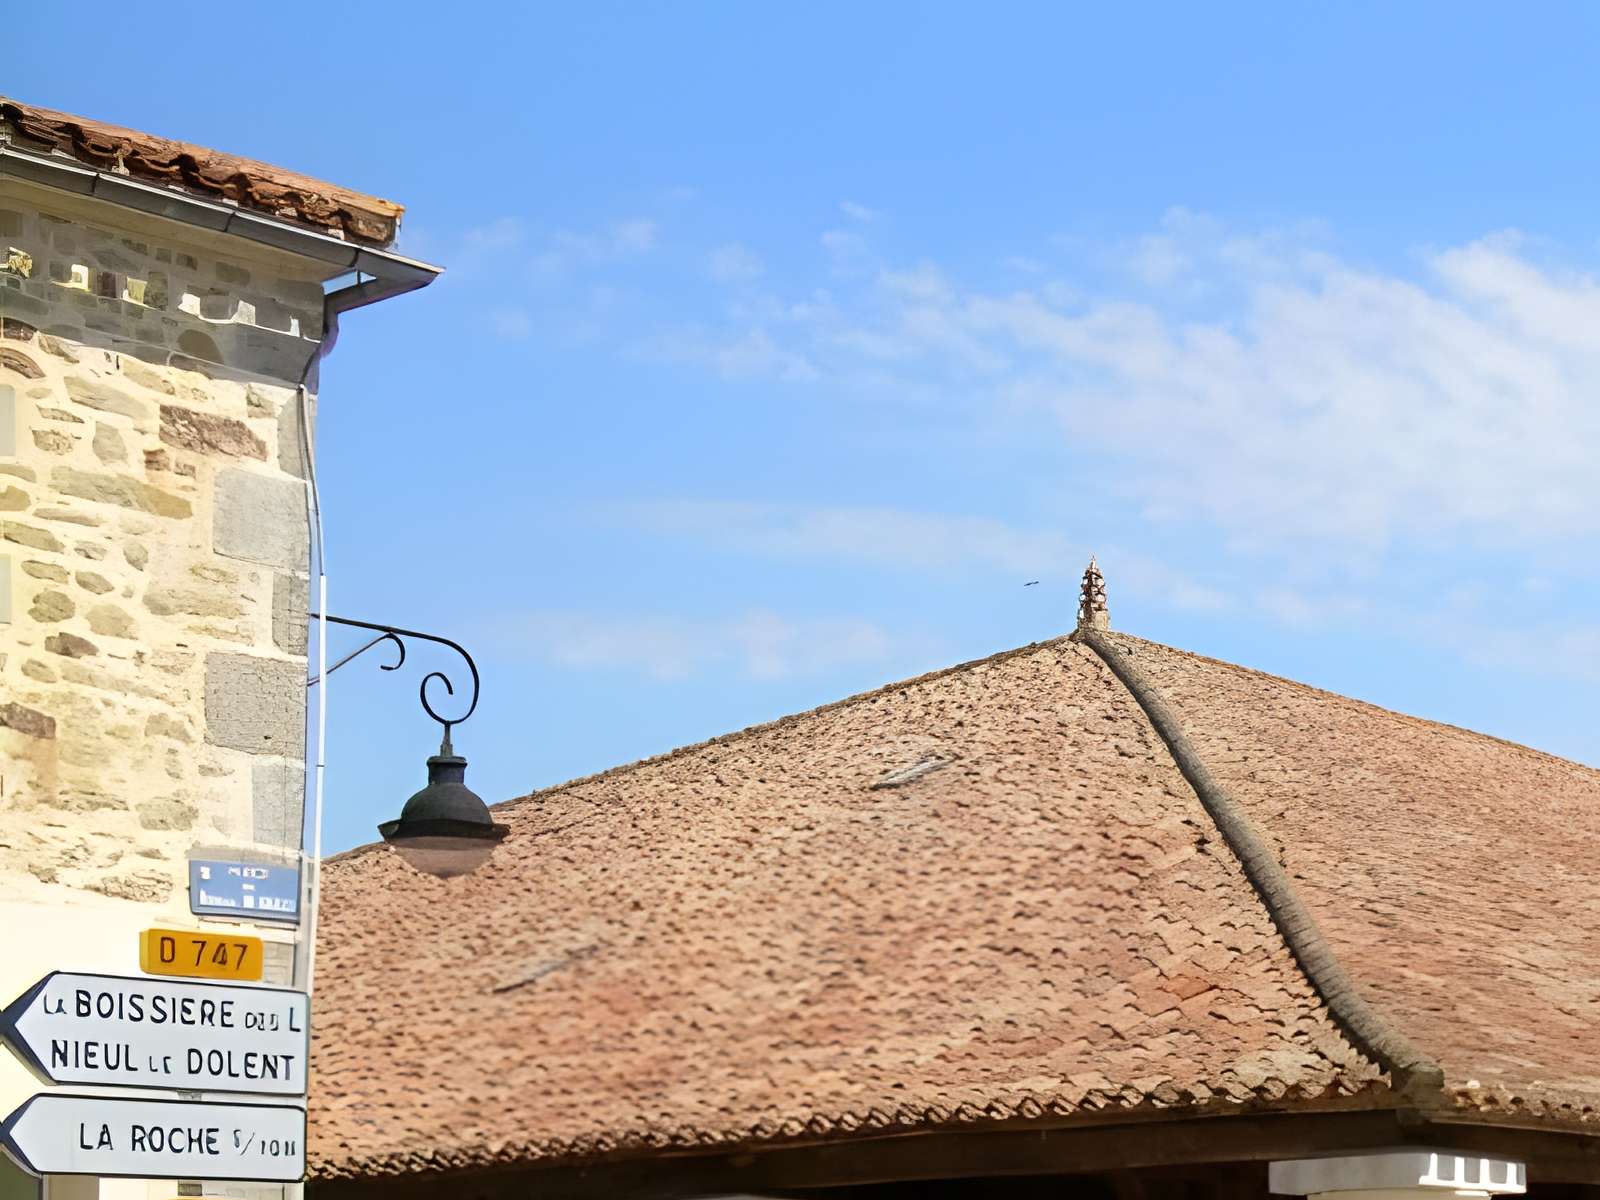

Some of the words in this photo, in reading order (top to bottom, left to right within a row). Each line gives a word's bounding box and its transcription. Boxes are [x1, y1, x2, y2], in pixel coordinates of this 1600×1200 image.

[160, 936, 176, 964] D
[192, 940, 248, 971] 747
[75, 989, 235, 1029] BOISSIERE
[51, 1039, 139, 1072] NIEUL
[187, 1048, 295, 1081] DOLENT
[79, 1122, 114, 1151] LA
[131, 1124, 220, 1155] ROCHE
